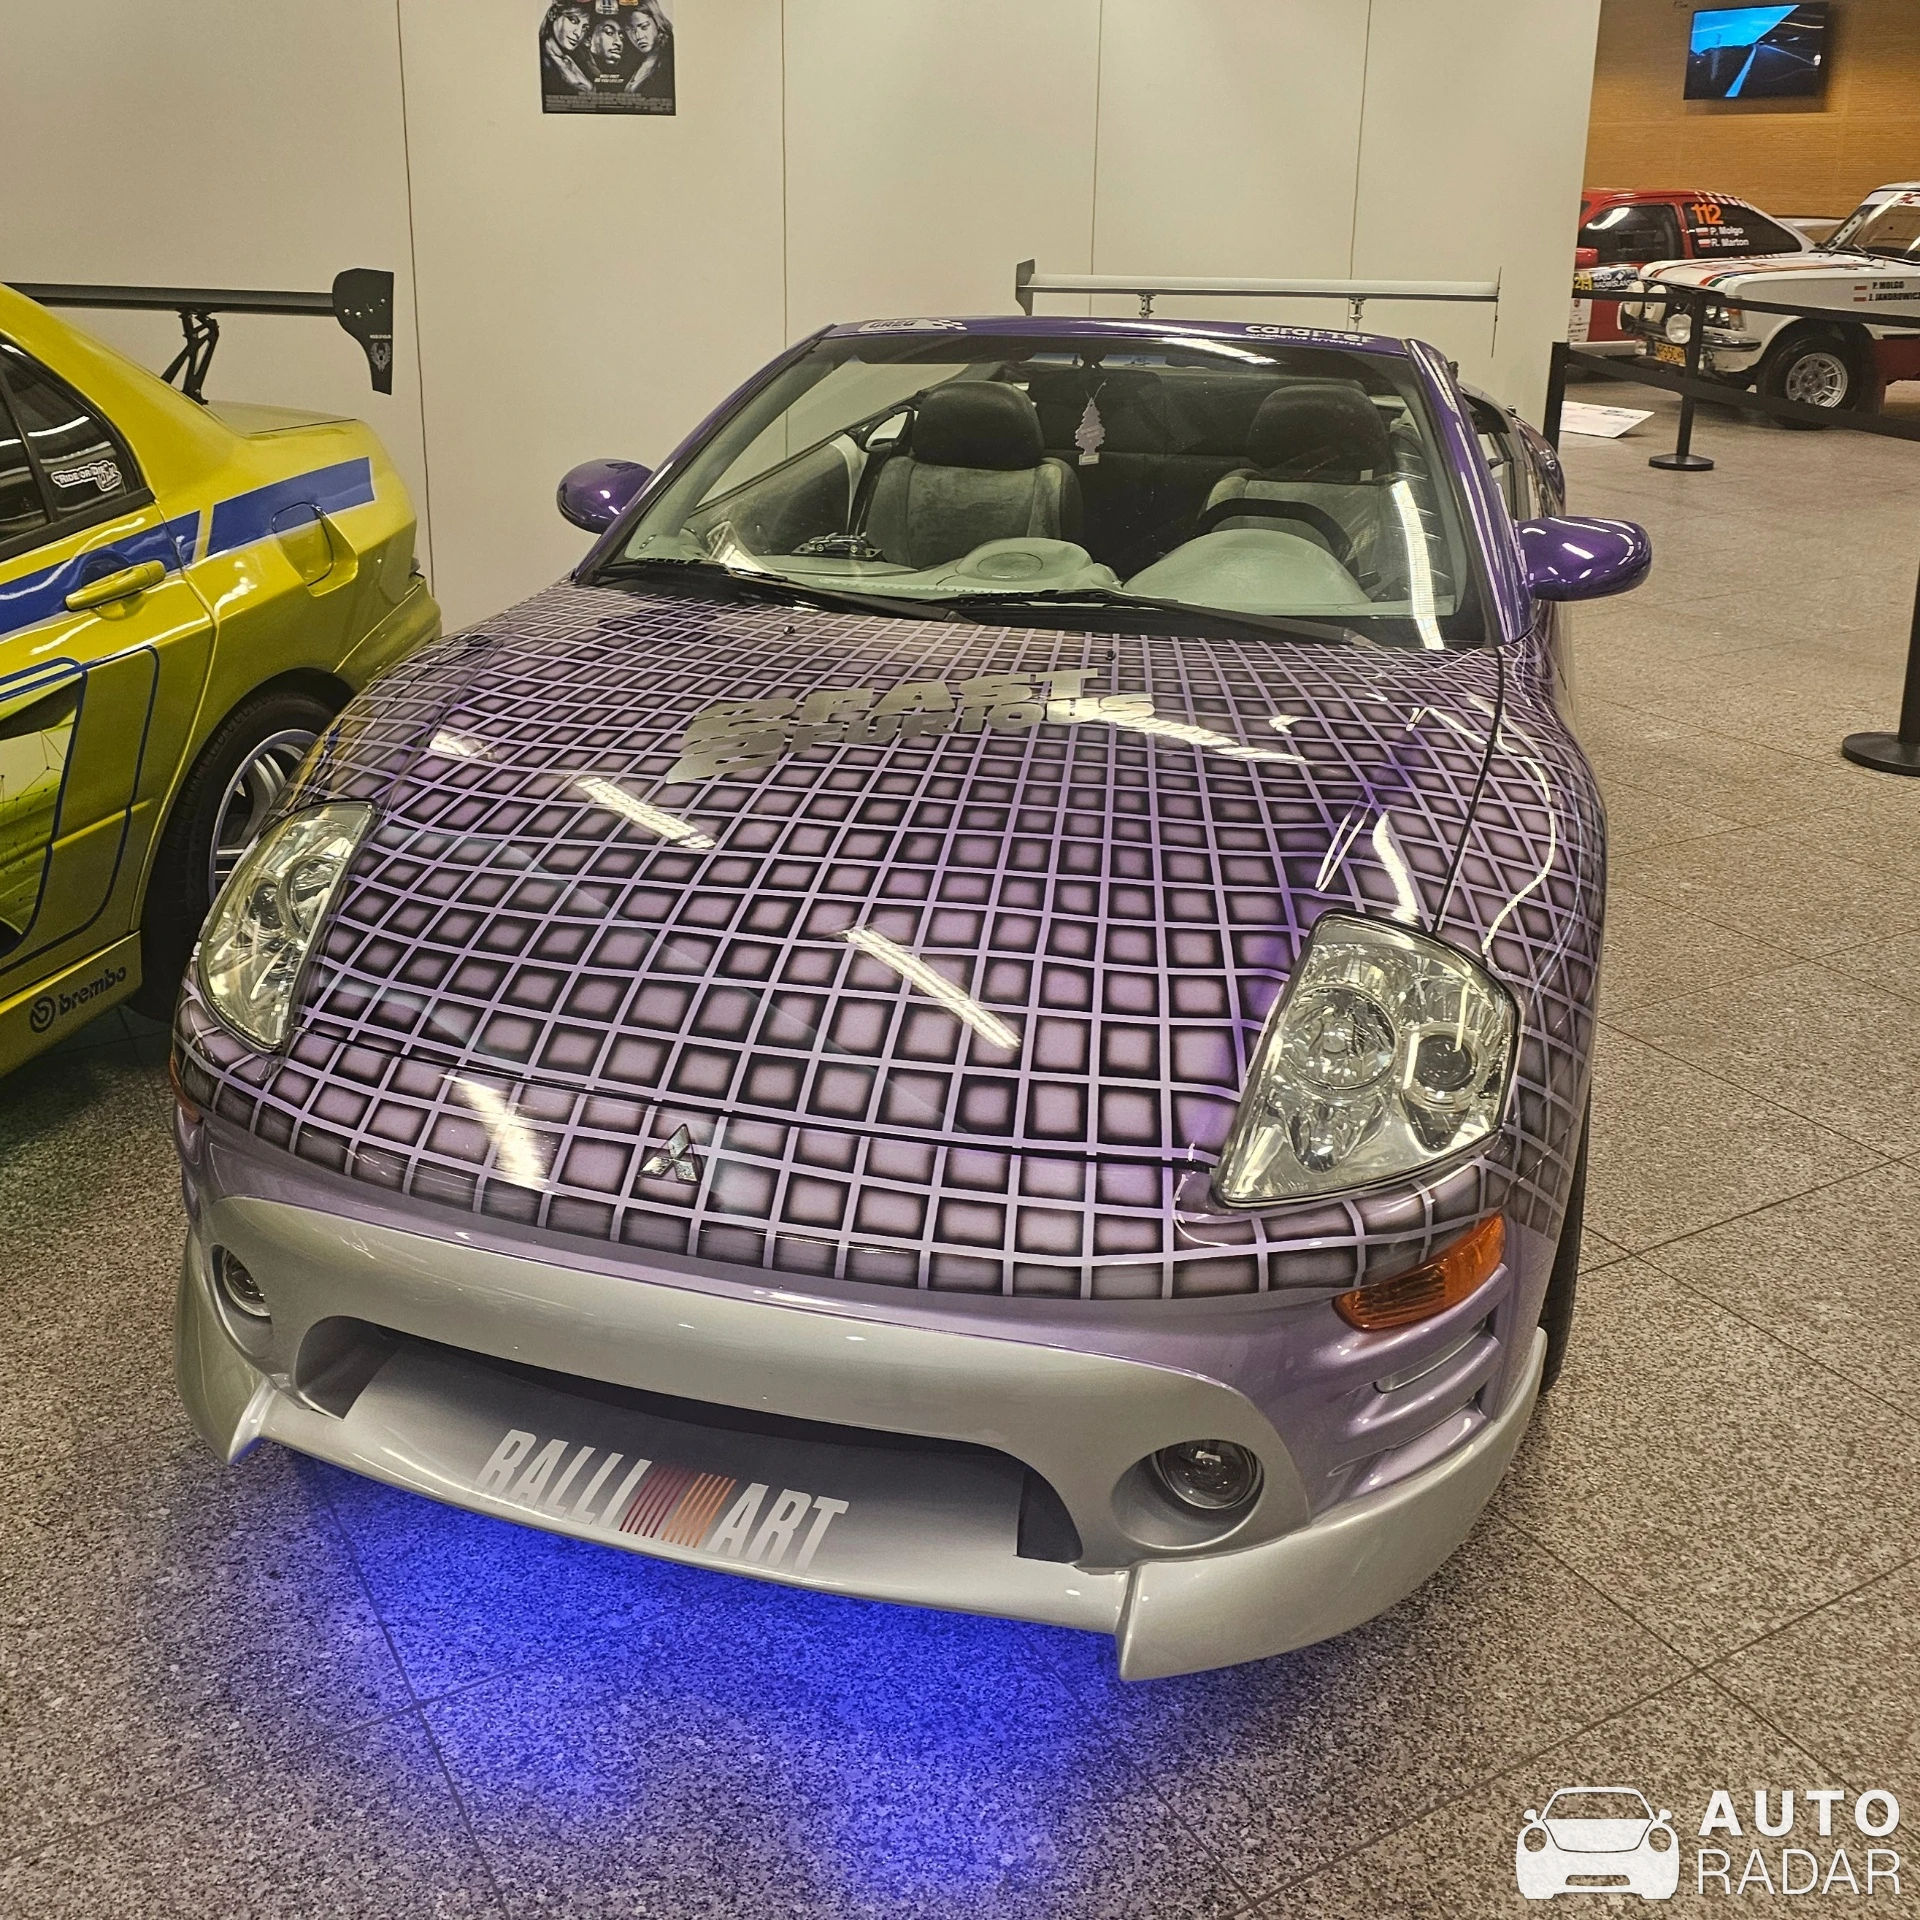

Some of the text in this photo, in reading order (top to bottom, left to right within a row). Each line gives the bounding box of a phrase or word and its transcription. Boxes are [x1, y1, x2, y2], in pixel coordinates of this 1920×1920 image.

[1691, 203, 1724, 225] 112
[1709, 226, 1744, 237] P. Molgo
[1710, 238, 1750, 247] R. Marton
[1879, 281, 1904, 290] MOLGO
[798, 668, 1098, 723] FAST
[789, 693, 1156, 754] FURIOUS
[57, 966, 127, 1016] brembo
[706, 1482, 850, 1574] ART
